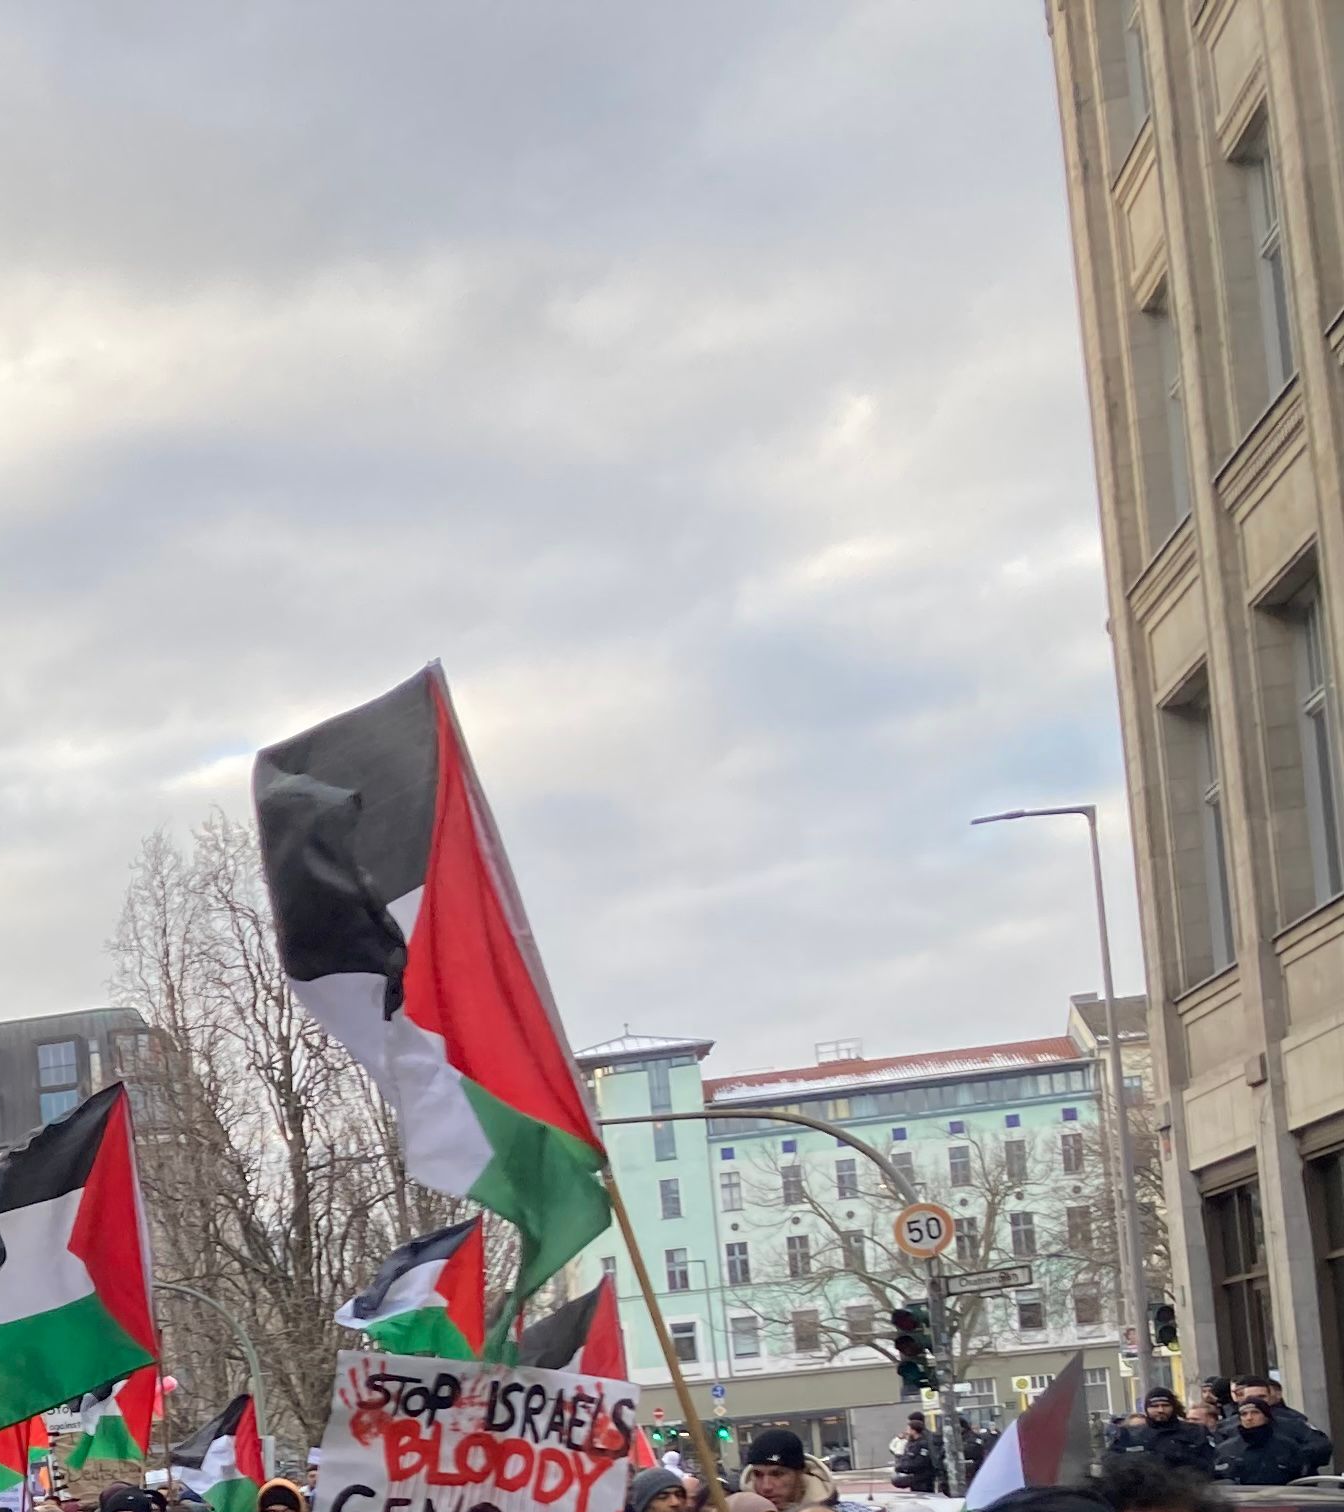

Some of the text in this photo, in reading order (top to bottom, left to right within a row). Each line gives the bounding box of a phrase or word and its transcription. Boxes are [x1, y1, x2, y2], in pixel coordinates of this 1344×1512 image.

[907, 1216, 942, 1243] 50
[357, 1373, 637, 1457] STOP ISRAELS
